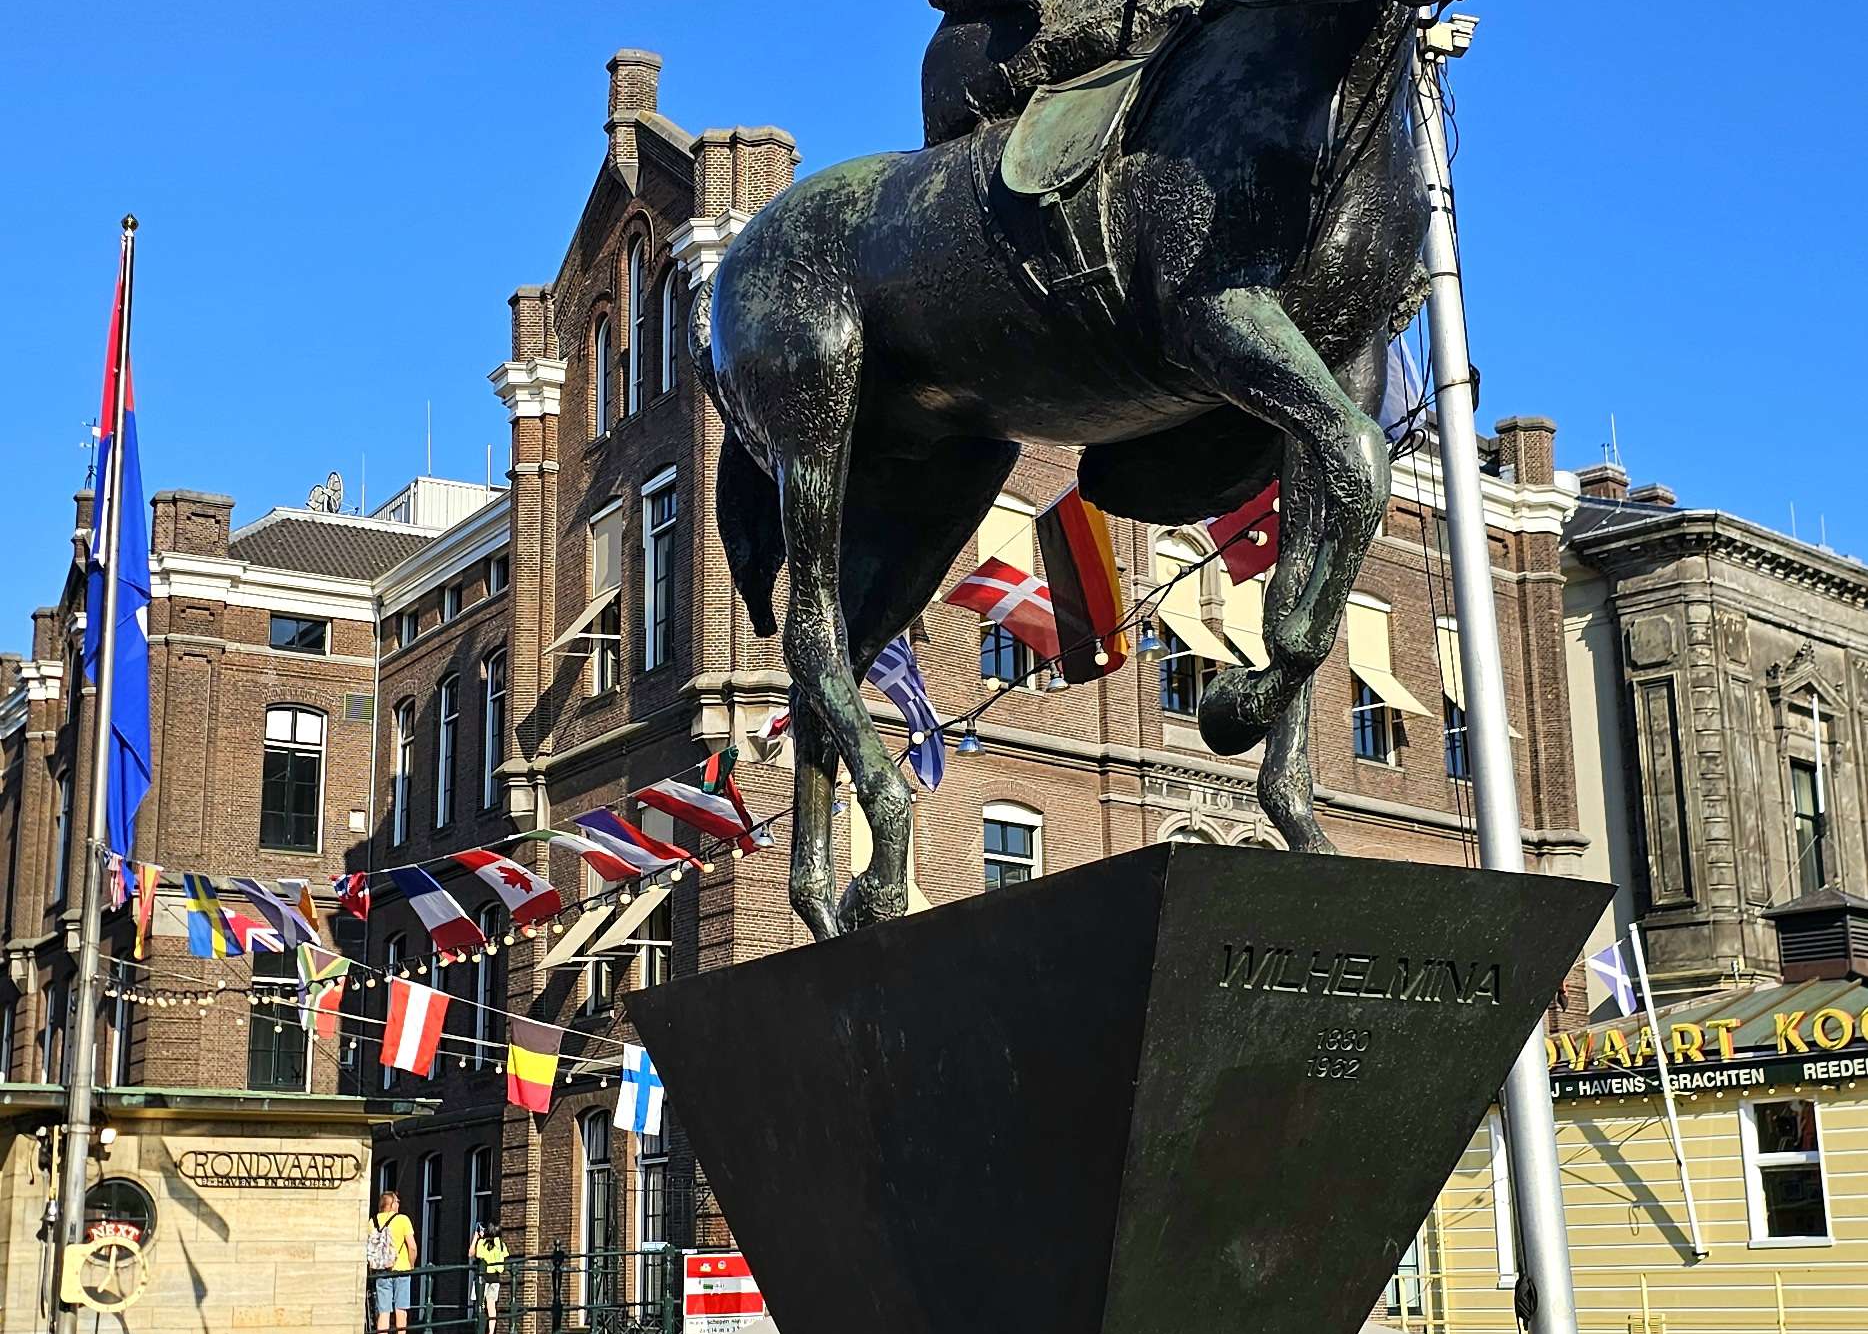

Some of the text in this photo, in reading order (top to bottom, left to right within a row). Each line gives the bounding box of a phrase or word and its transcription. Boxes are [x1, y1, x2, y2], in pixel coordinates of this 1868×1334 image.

[1219, 944, 1501, 1006] WILHELMINA
[1317, 1028, 1372, 1052] 1880
[1774, 1006, 1868, 1055] KO
[1305, 1057, 1362, 1080] 1962
[1578, 1076, 1646, 1096] HAVENS
[1668, 1067, 1765, 1090] GRACHTEN
[1803, 1057, 1868, 1080] REEDE
[194, 1153, 349, 1179] RONDVAART
[91, 1221, 140, 1241] NEXT
